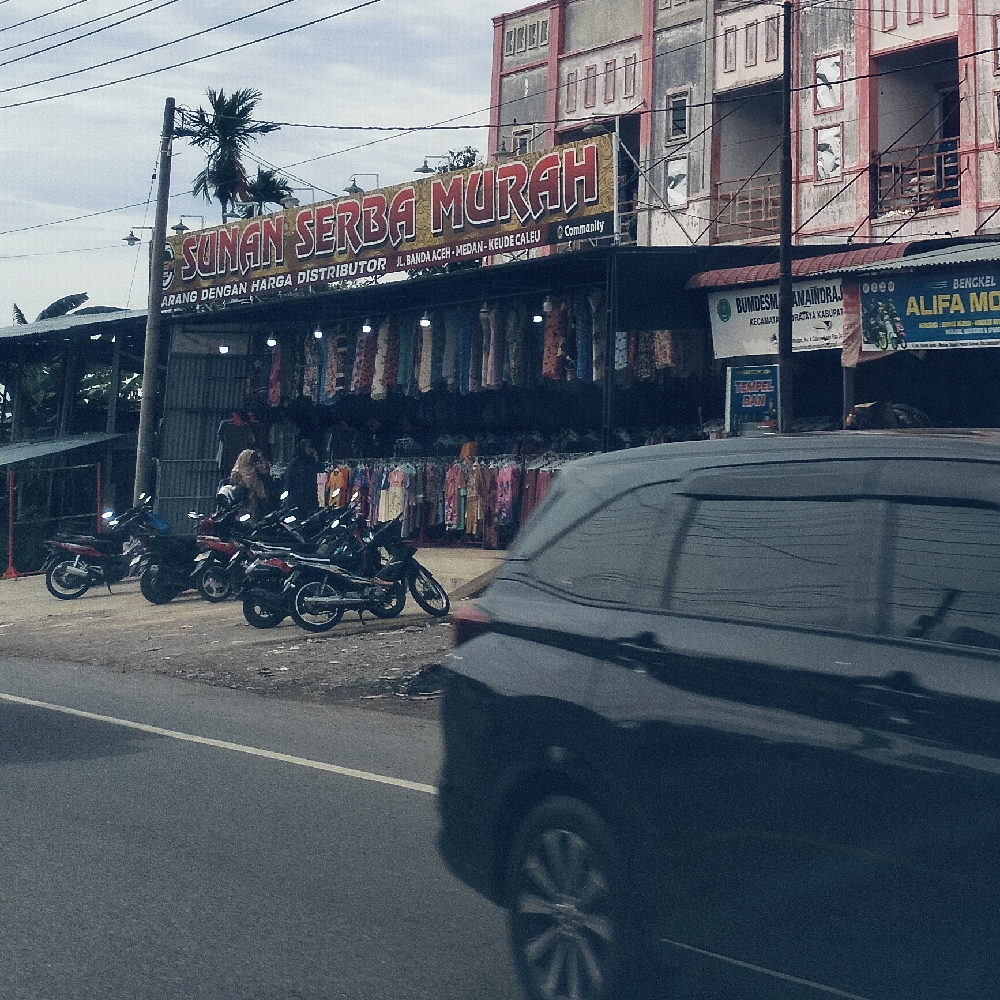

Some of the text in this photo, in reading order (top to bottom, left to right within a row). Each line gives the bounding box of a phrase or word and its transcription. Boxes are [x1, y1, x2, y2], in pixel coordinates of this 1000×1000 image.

[181, 142, 598, 281] SUNAN SERBA MURAH
[406, 250, 431, 265] BANDA
[431, 246, 451, 261] ACEH
[455, 240, 483, 257] MEDAN
[488, 234, 514, 251] KEUDE
[515, 229, 541, 246] CALEU
[161, 257, 387, 307] ARANG DENGAN HARGA DISTRIBUTOR
[953, 275, 996, 290] BENGKEL
[735, 293, 779, 314] BUMDESM
[906, 293, 965, 316] ALIFA
[750, 316, 779, 327] KECAMATA
[817, 308, 843, 319] KABUPAT
[734, 379, 774, 393] TEMPEL
[742, 393, 766, 408] BAN
